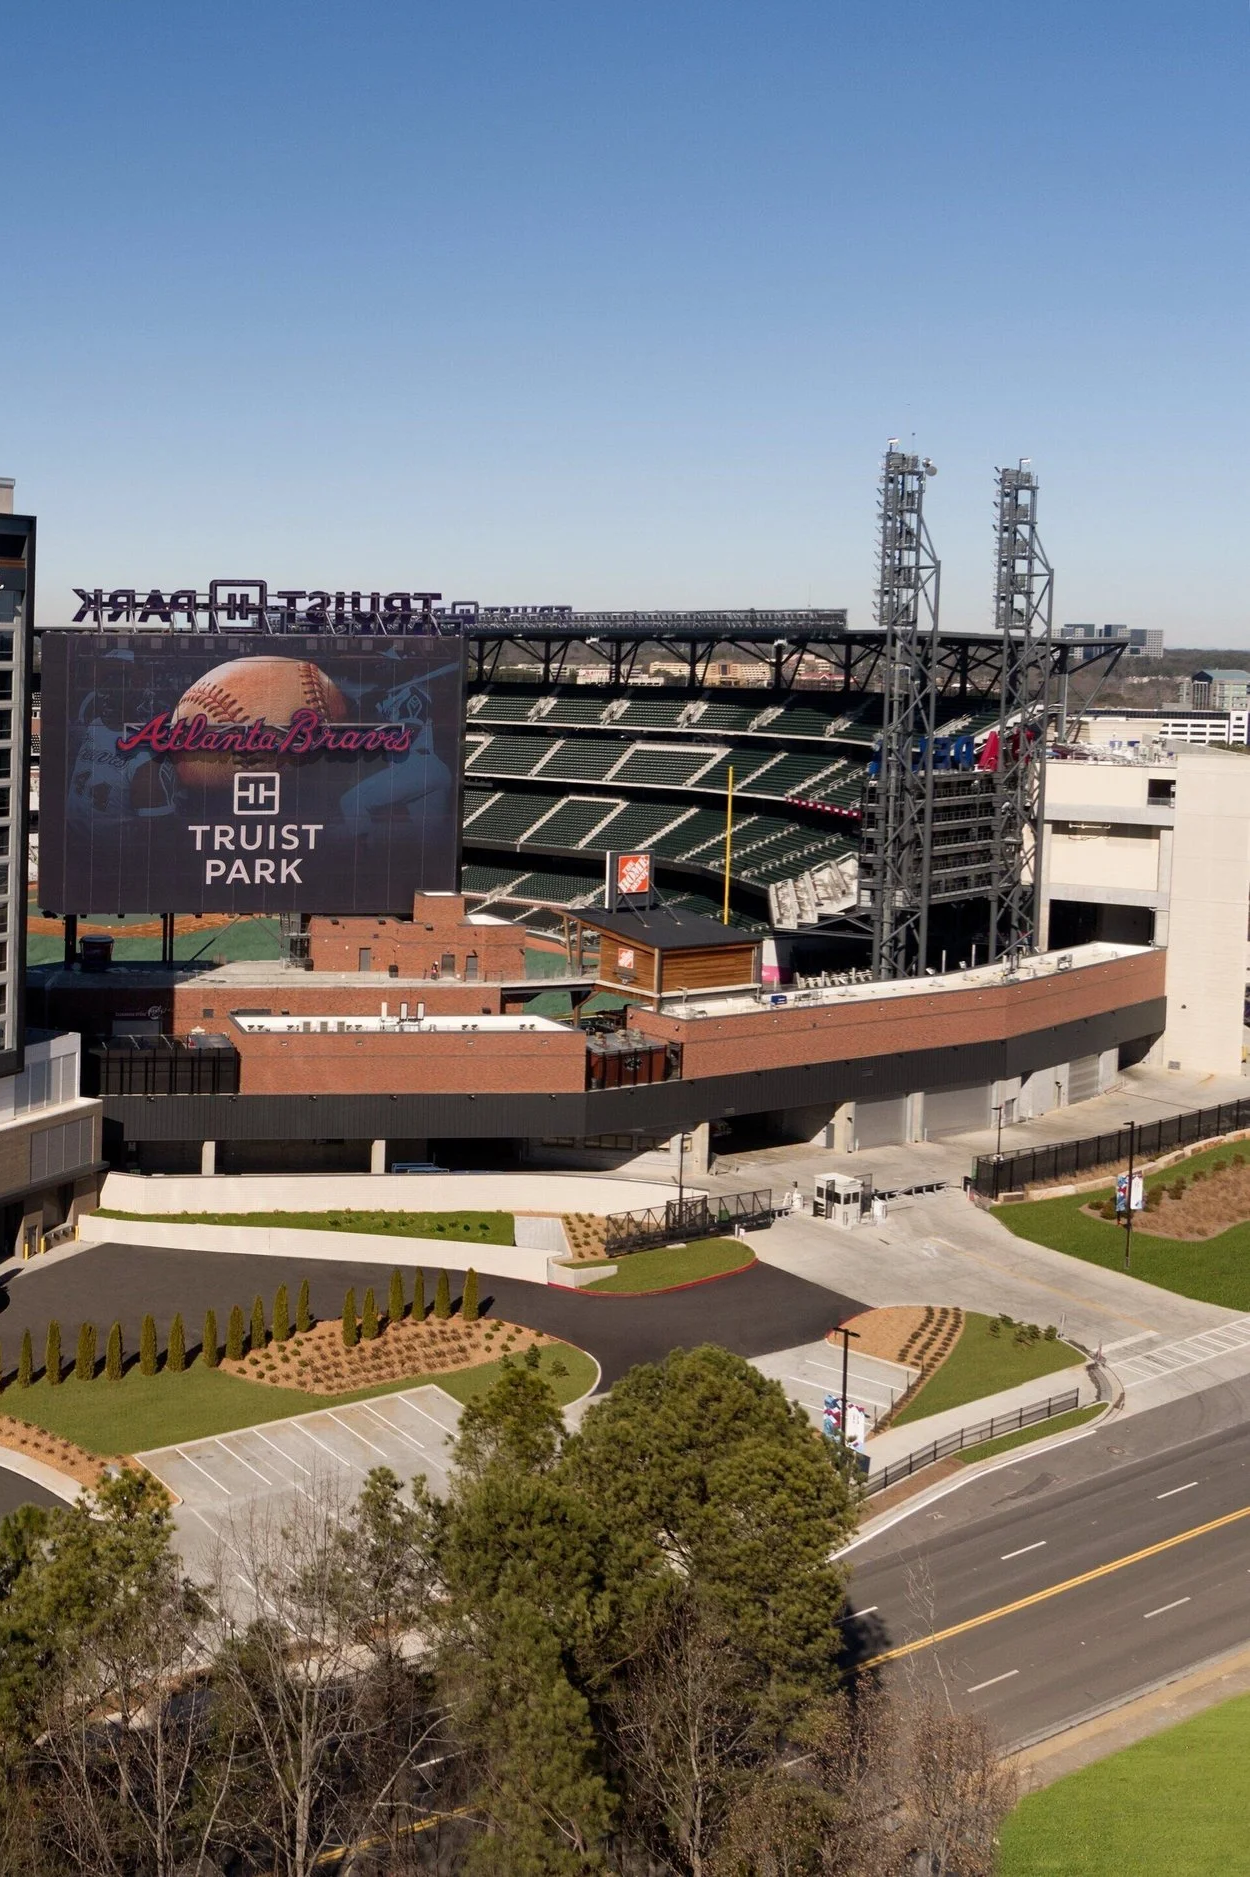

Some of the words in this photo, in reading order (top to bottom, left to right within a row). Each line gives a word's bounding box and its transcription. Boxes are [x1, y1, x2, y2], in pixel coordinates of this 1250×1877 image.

[117, 711, 280, 751] Atlanta
[279, 708, 415, 752] Braves
[188, 824, 324, 851] TRUIST
[205, 858, 303, 885] PARK
